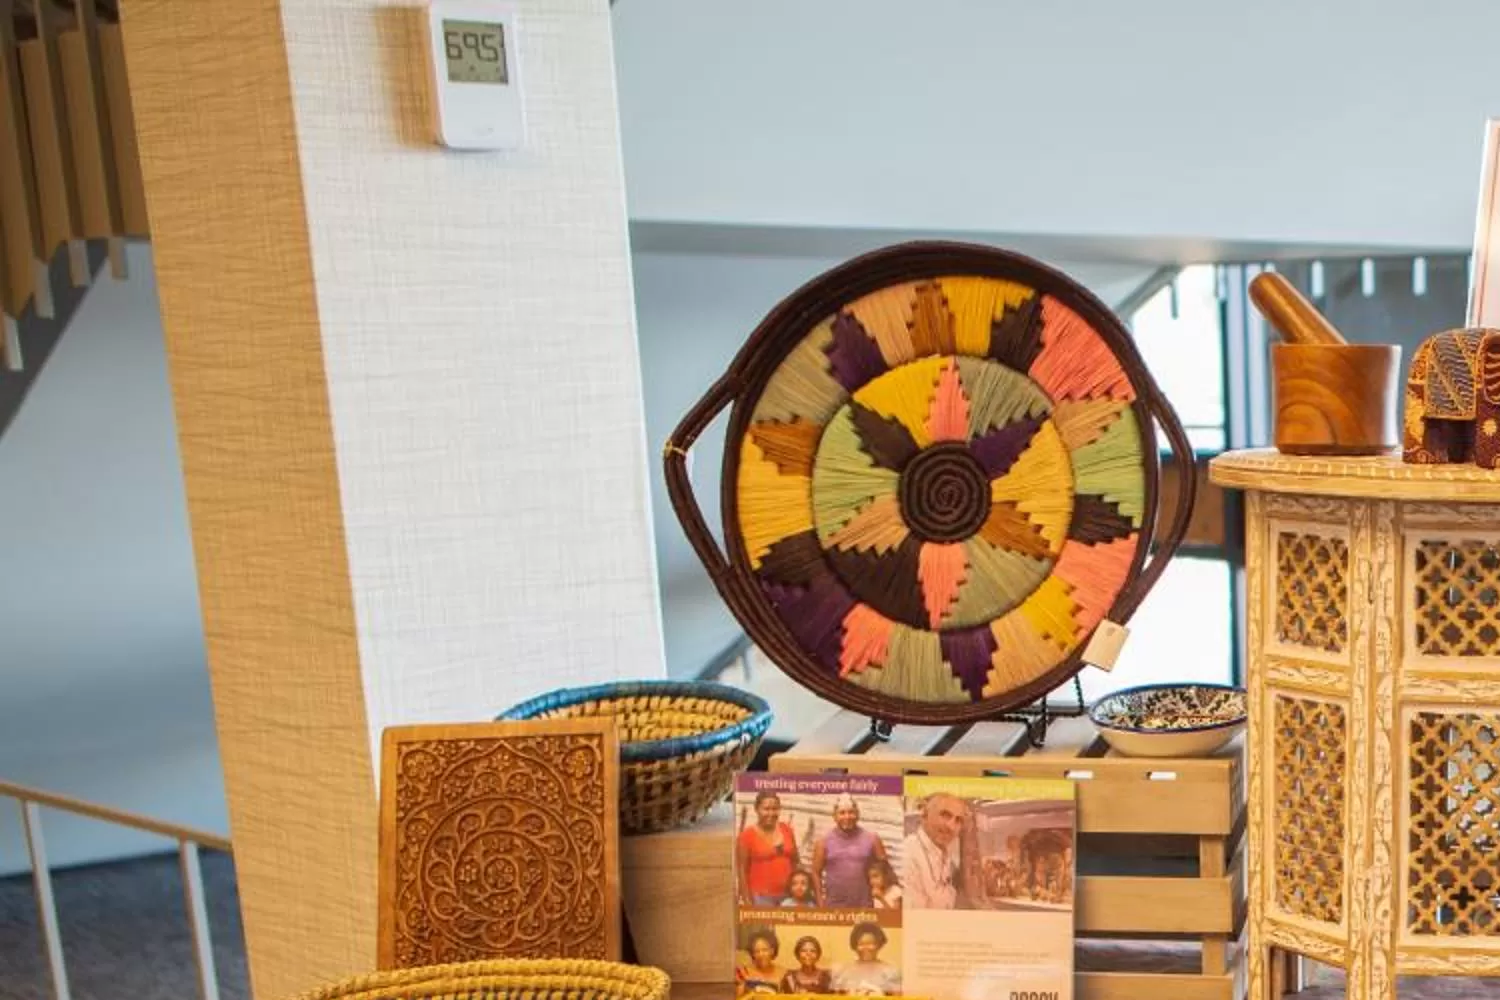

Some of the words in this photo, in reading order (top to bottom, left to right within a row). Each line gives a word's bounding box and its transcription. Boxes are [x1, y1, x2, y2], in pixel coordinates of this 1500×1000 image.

[755, 779, 797, 793] treating
[798, 780, 848, 793] everyone
[850, 779, 878, 793] fairly
